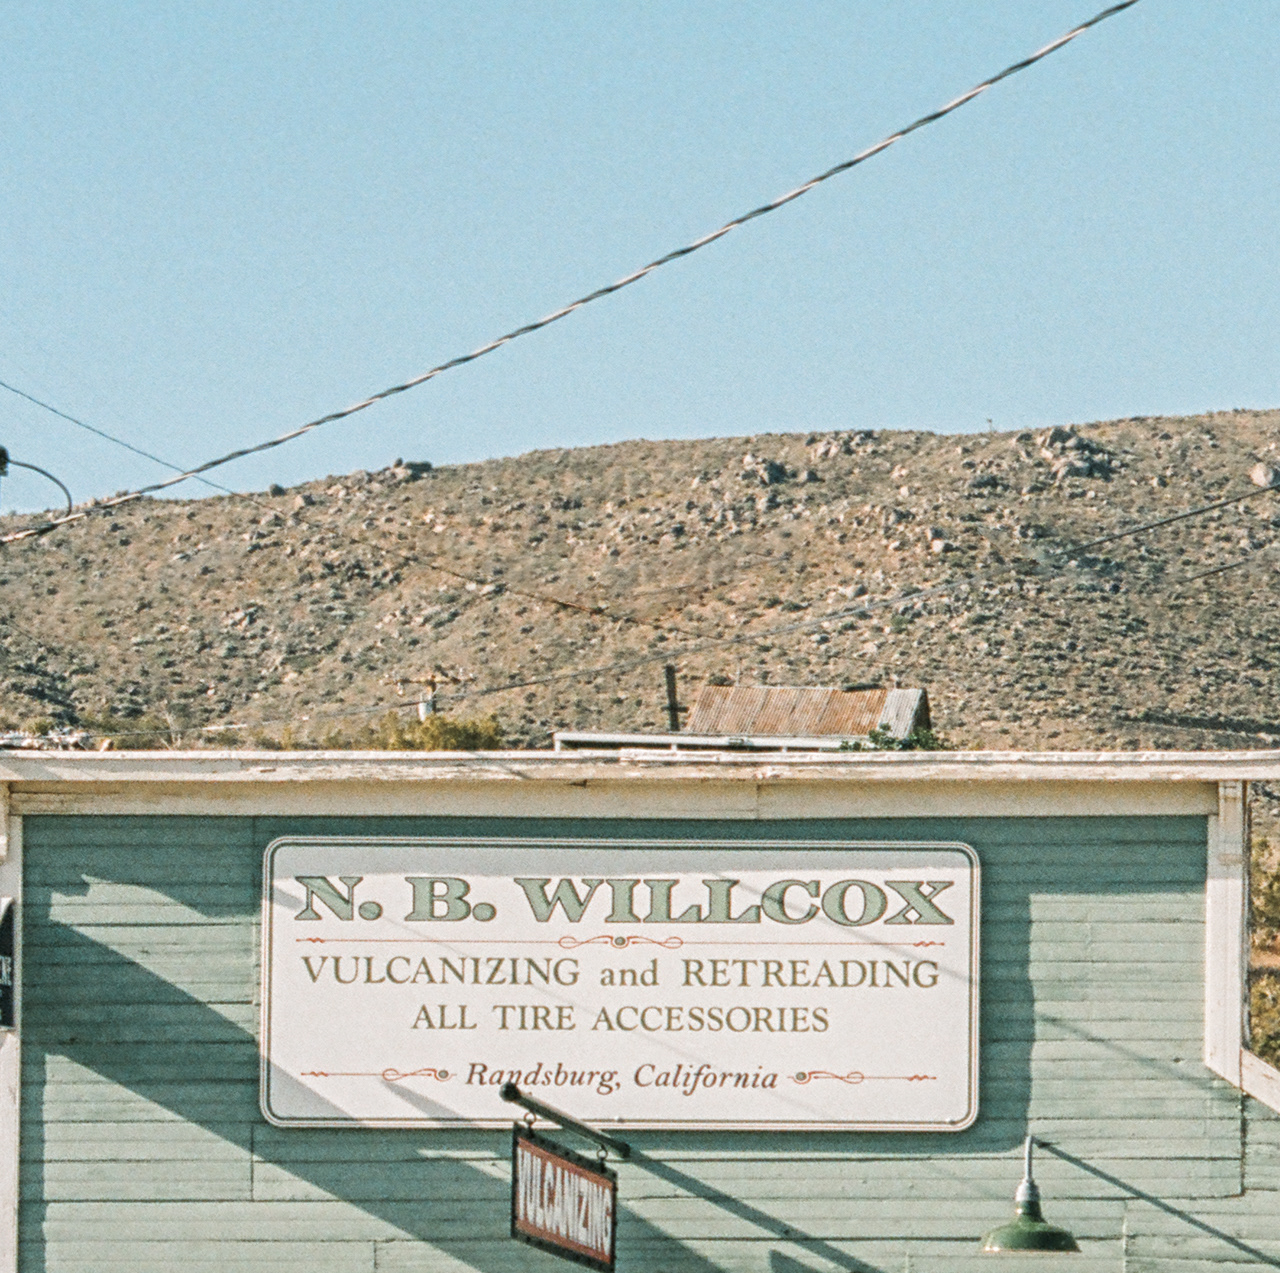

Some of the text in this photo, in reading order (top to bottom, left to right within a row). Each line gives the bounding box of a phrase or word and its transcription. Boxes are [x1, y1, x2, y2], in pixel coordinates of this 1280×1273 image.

[294, 875, 956, 926] N. B. WILLCOX
[301, 955, 940, 989] VULCANIZING and RETREADING
[411, 1004, 830, 1033] ALL TIRE ACCESSORIES
[465, 1062, 778, 1097] Randsburg, California
[515, 1146, 613, 1256] VULCANIZING
